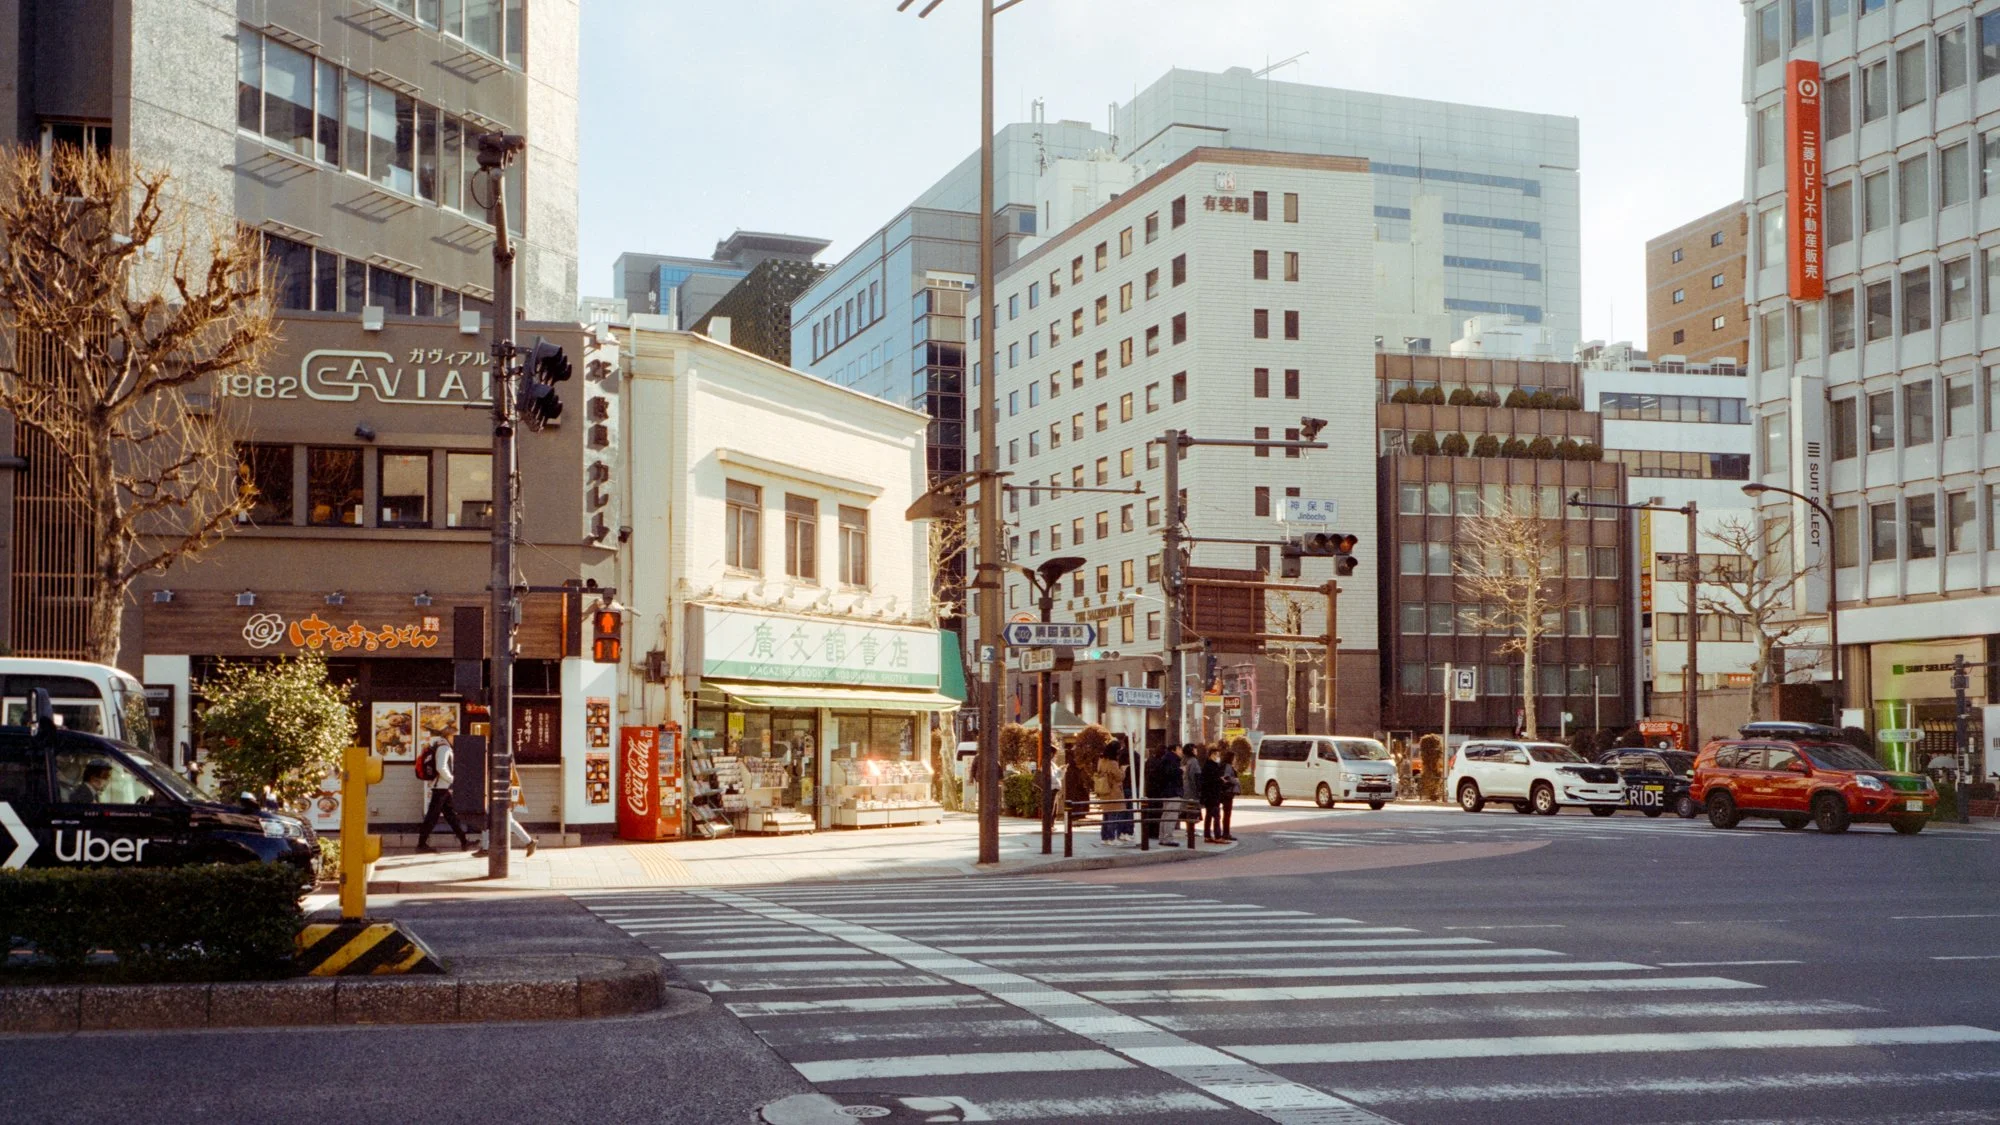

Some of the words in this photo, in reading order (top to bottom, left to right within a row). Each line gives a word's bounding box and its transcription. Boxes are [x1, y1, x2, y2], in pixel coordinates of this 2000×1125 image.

[1803, 130, 1818, 279] 三菱UFJ不動産販売
[408, 348, 490, 366] ガヴィアル
[1810, 463, 1819, 492] SUIT
[1290, 501, 1334, 512] 神保町
[1810, 497, 1820, 547] SELECT
[289, 613, 438, 651] はなまるうどん
[749, 624, 908, 668] 廣文館書店
[55, 830, 149, 862] Uber
